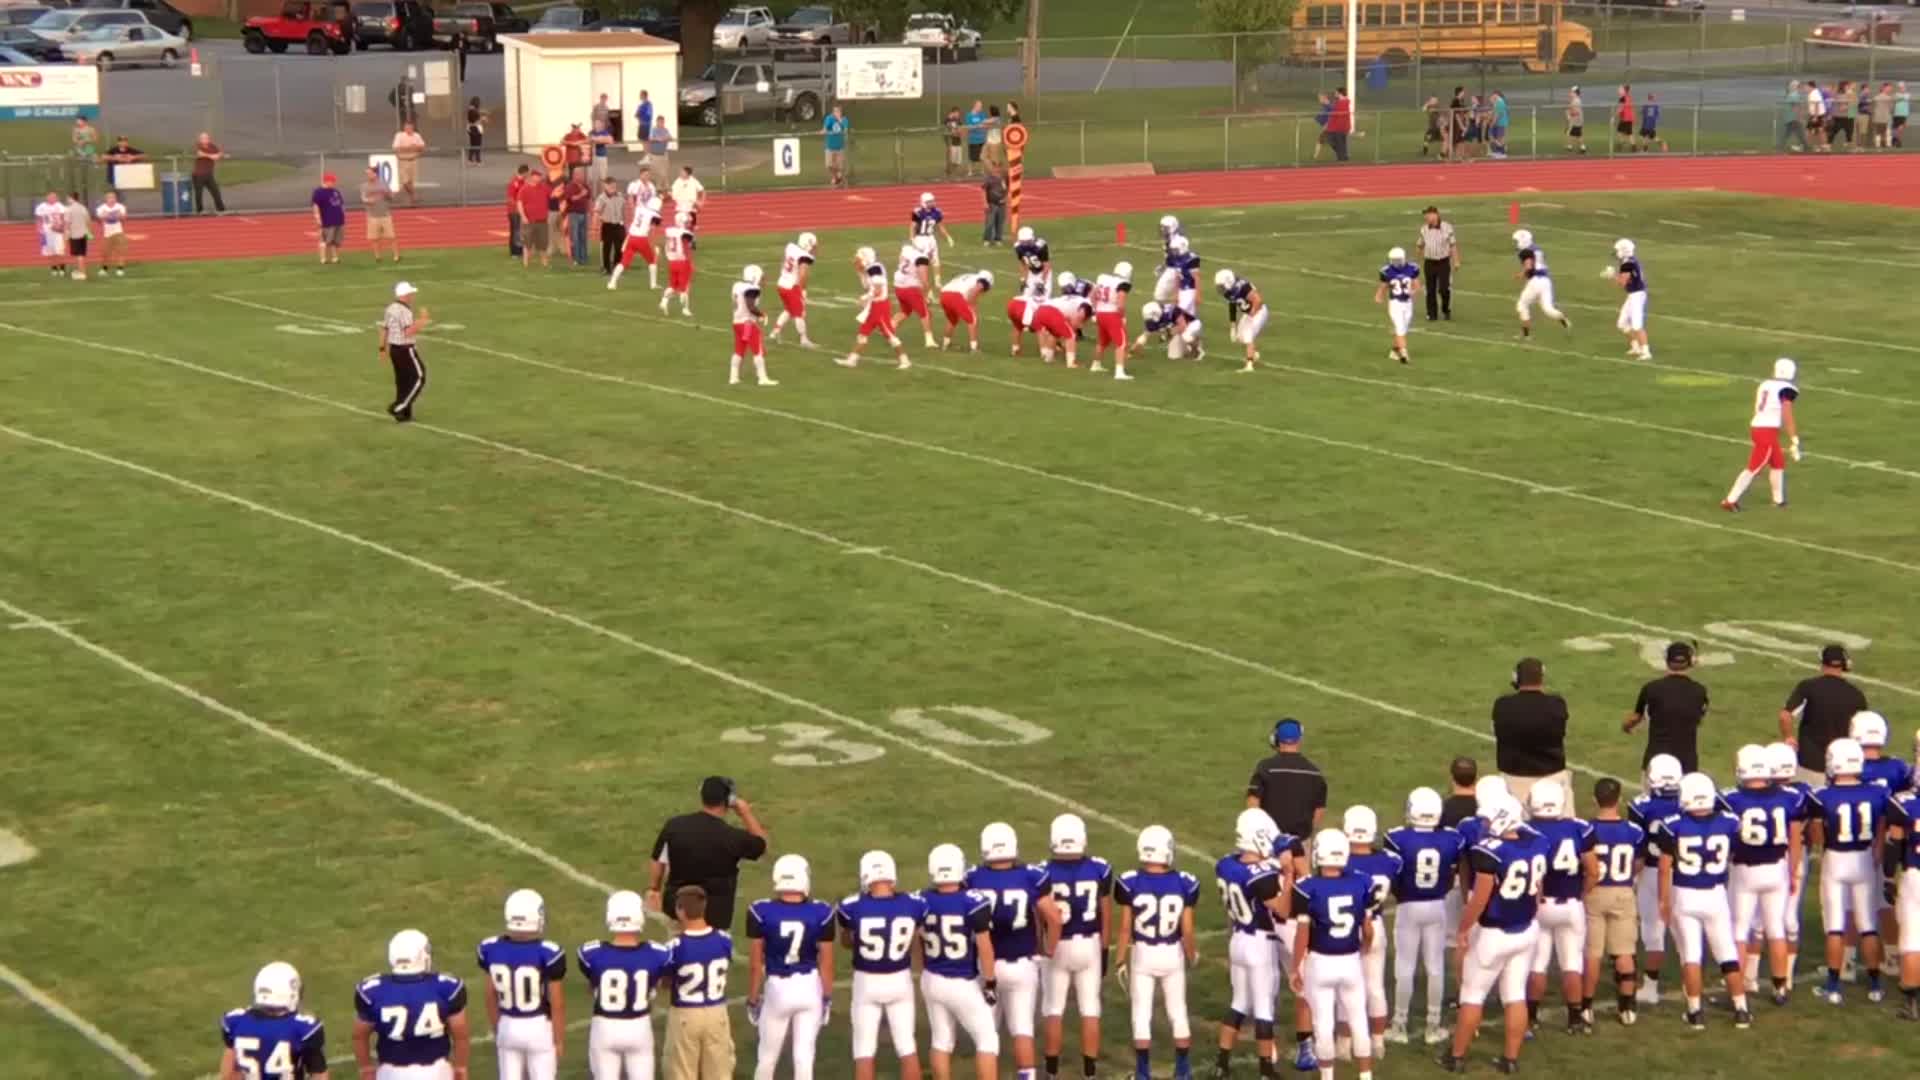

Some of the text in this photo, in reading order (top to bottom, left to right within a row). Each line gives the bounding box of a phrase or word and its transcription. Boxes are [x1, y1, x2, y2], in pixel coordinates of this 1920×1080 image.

[782, 144, 793, 168] G
[1390, 277, 1412, 295] 33
[720, 703, 1053, 766] 30
[1741, 807, 1788, 845] 61
[1837, 802, 1873, 842] 11
[1416, 848, 1440, 888] 8
[1678, 834, 1729, 875] 53
[1132, 894, 1184, 937] 28
[1328, 896, 1354, 939] 5
[780, 920, 805, 964] 7
[860, 917, 916, 960] 58
[489, 963, 541, 1012] 90
[599, 968, 650, 1012] 81
[677, 963, 727, 1003] 26
[380, 1003, 446, 1041] 74
[234, 1036, 295, 1080] 54
